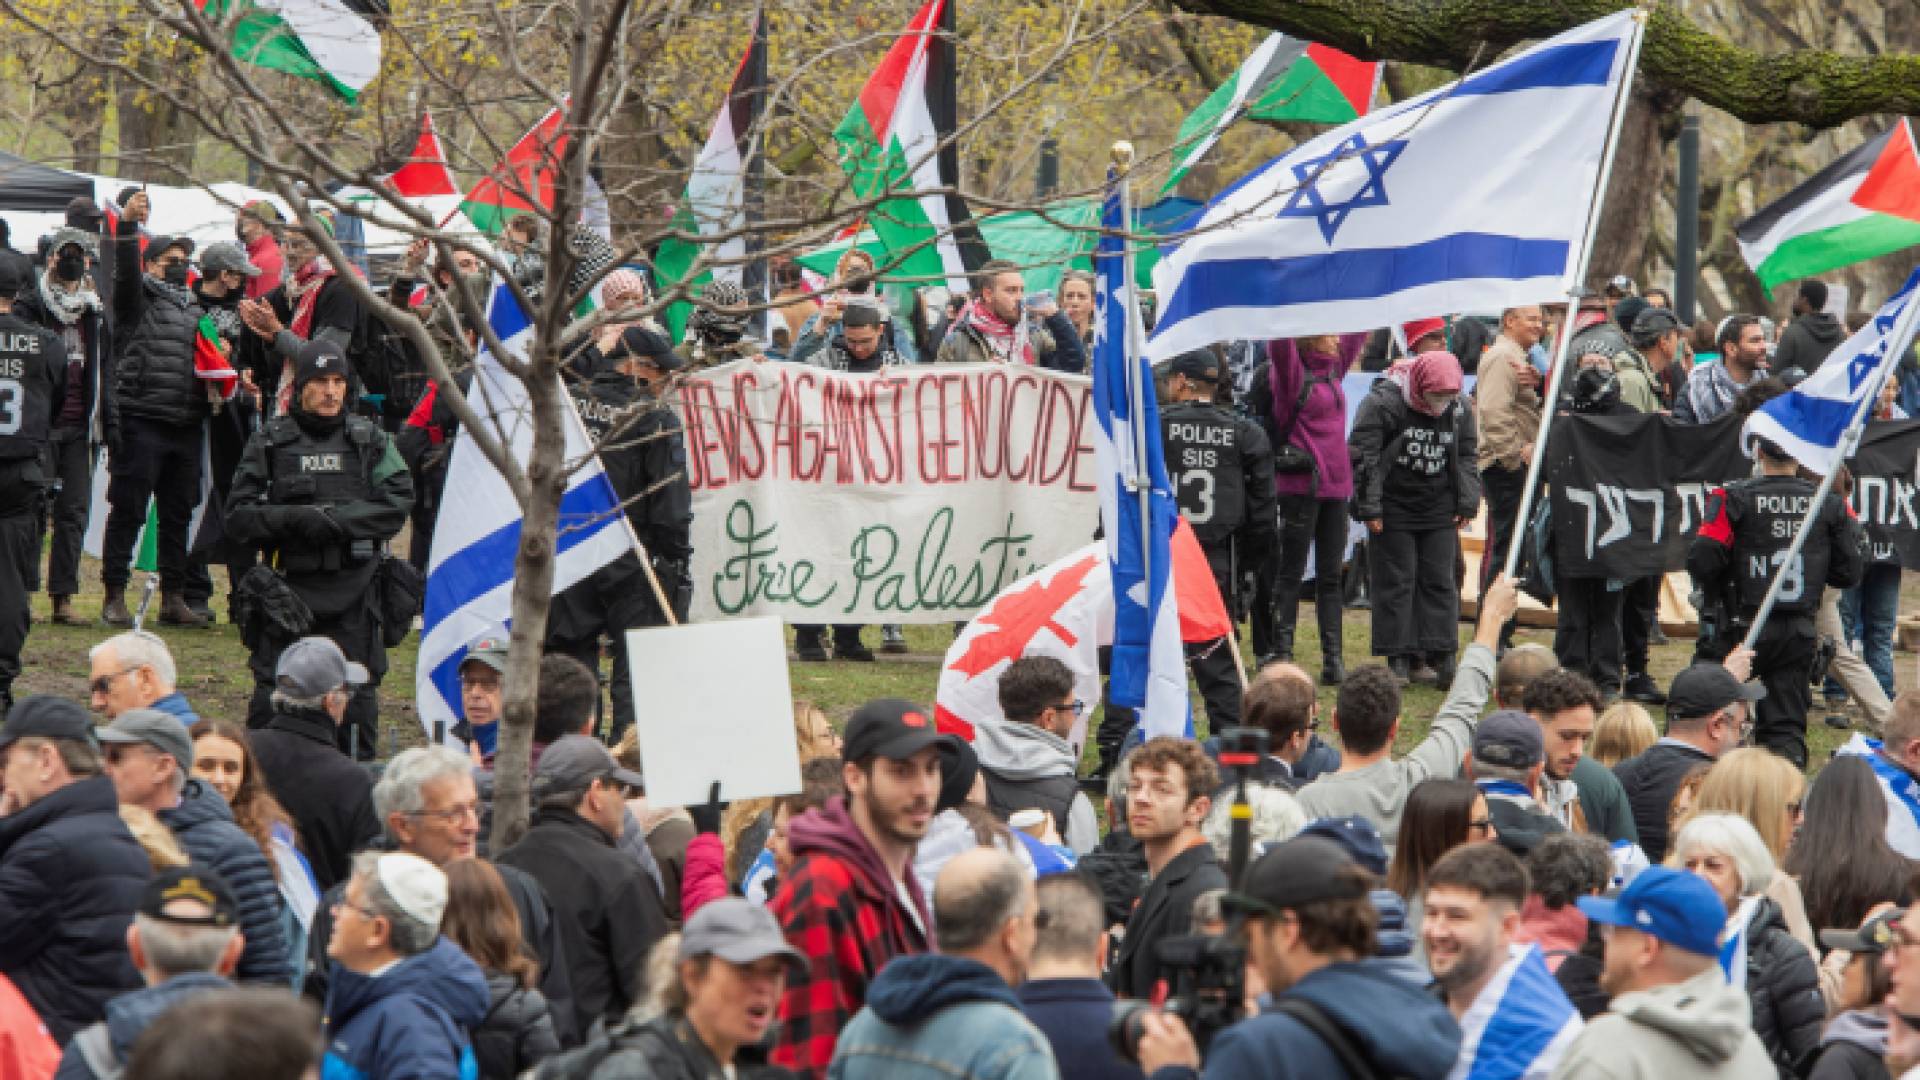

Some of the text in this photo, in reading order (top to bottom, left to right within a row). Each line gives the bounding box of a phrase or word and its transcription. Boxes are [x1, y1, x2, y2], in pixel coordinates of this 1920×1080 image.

[676, 367, 1098, 493] JEWS AGAINST GENOCIDE
[1168, 423, 1235, 447] POLICE
[1182, 447, 1218, 468] SIS
